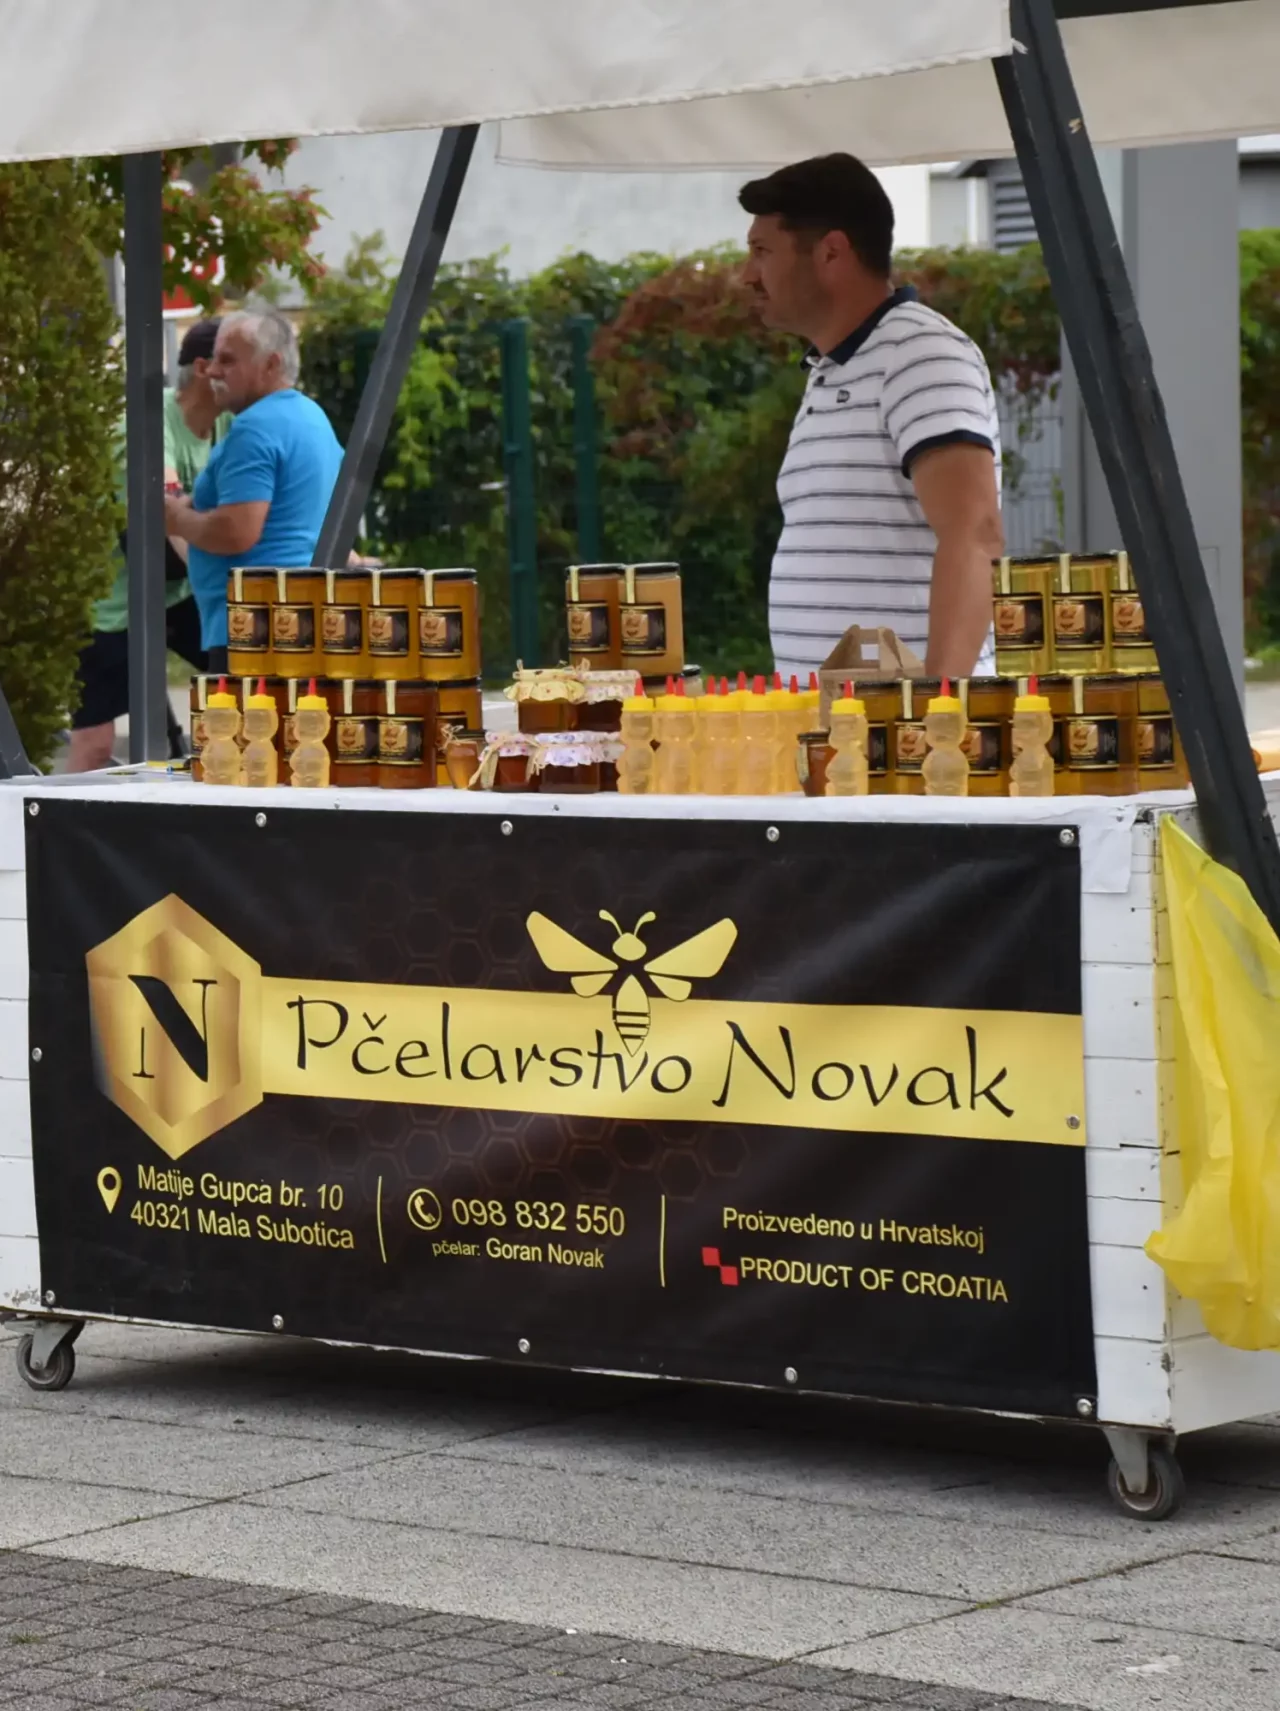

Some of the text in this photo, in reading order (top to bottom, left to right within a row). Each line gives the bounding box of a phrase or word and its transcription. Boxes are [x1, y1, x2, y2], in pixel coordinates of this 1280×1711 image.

[126, 974, 218, 1083] N
[286, 995, 1014, 1118] Pčelarstvo Novak
[138, 1165, 344, 1211] Matije Gupca br. 10
[131, 1200, 354, 1249] 40321 Mala Subotica
[452, 1198, 625, 1236] 098 832 550
[722, 1207, 985, 1254] Proizvedeno u Hrvatskoj
[432, 1239, 604, 1269] pčelar: Goran Novak
[740, 1257, 1008, 1303] PRODUCT OF CROATIA
